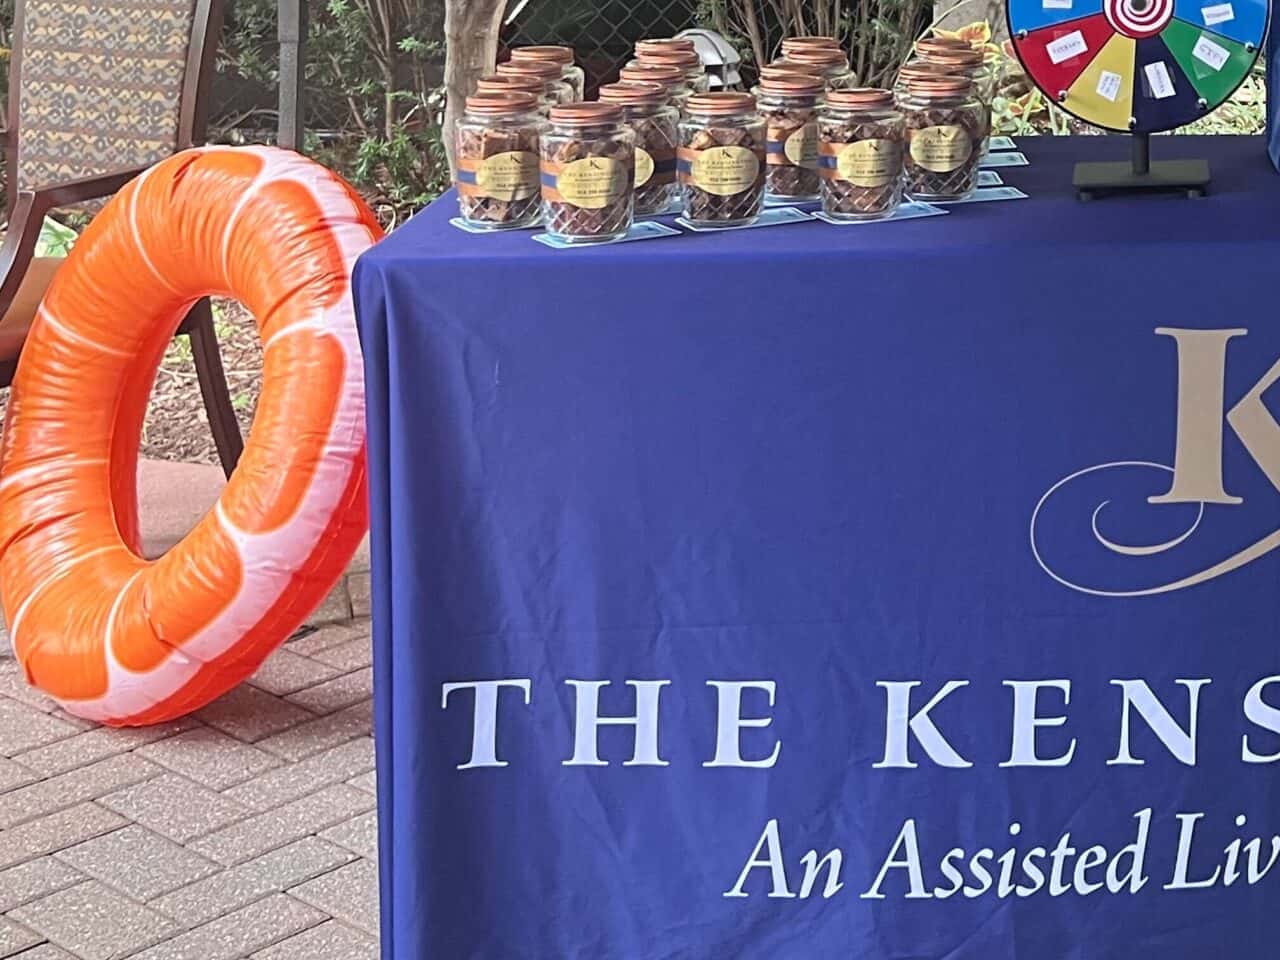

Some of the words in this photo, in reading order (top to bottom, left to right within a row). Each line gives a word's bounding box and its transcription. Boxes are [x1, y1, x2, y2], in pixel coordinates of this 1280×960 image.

[441, 678, 781, 770] THE
[722, 819, 844, 899] An
[859, 807, 1152, 899] Assisted
